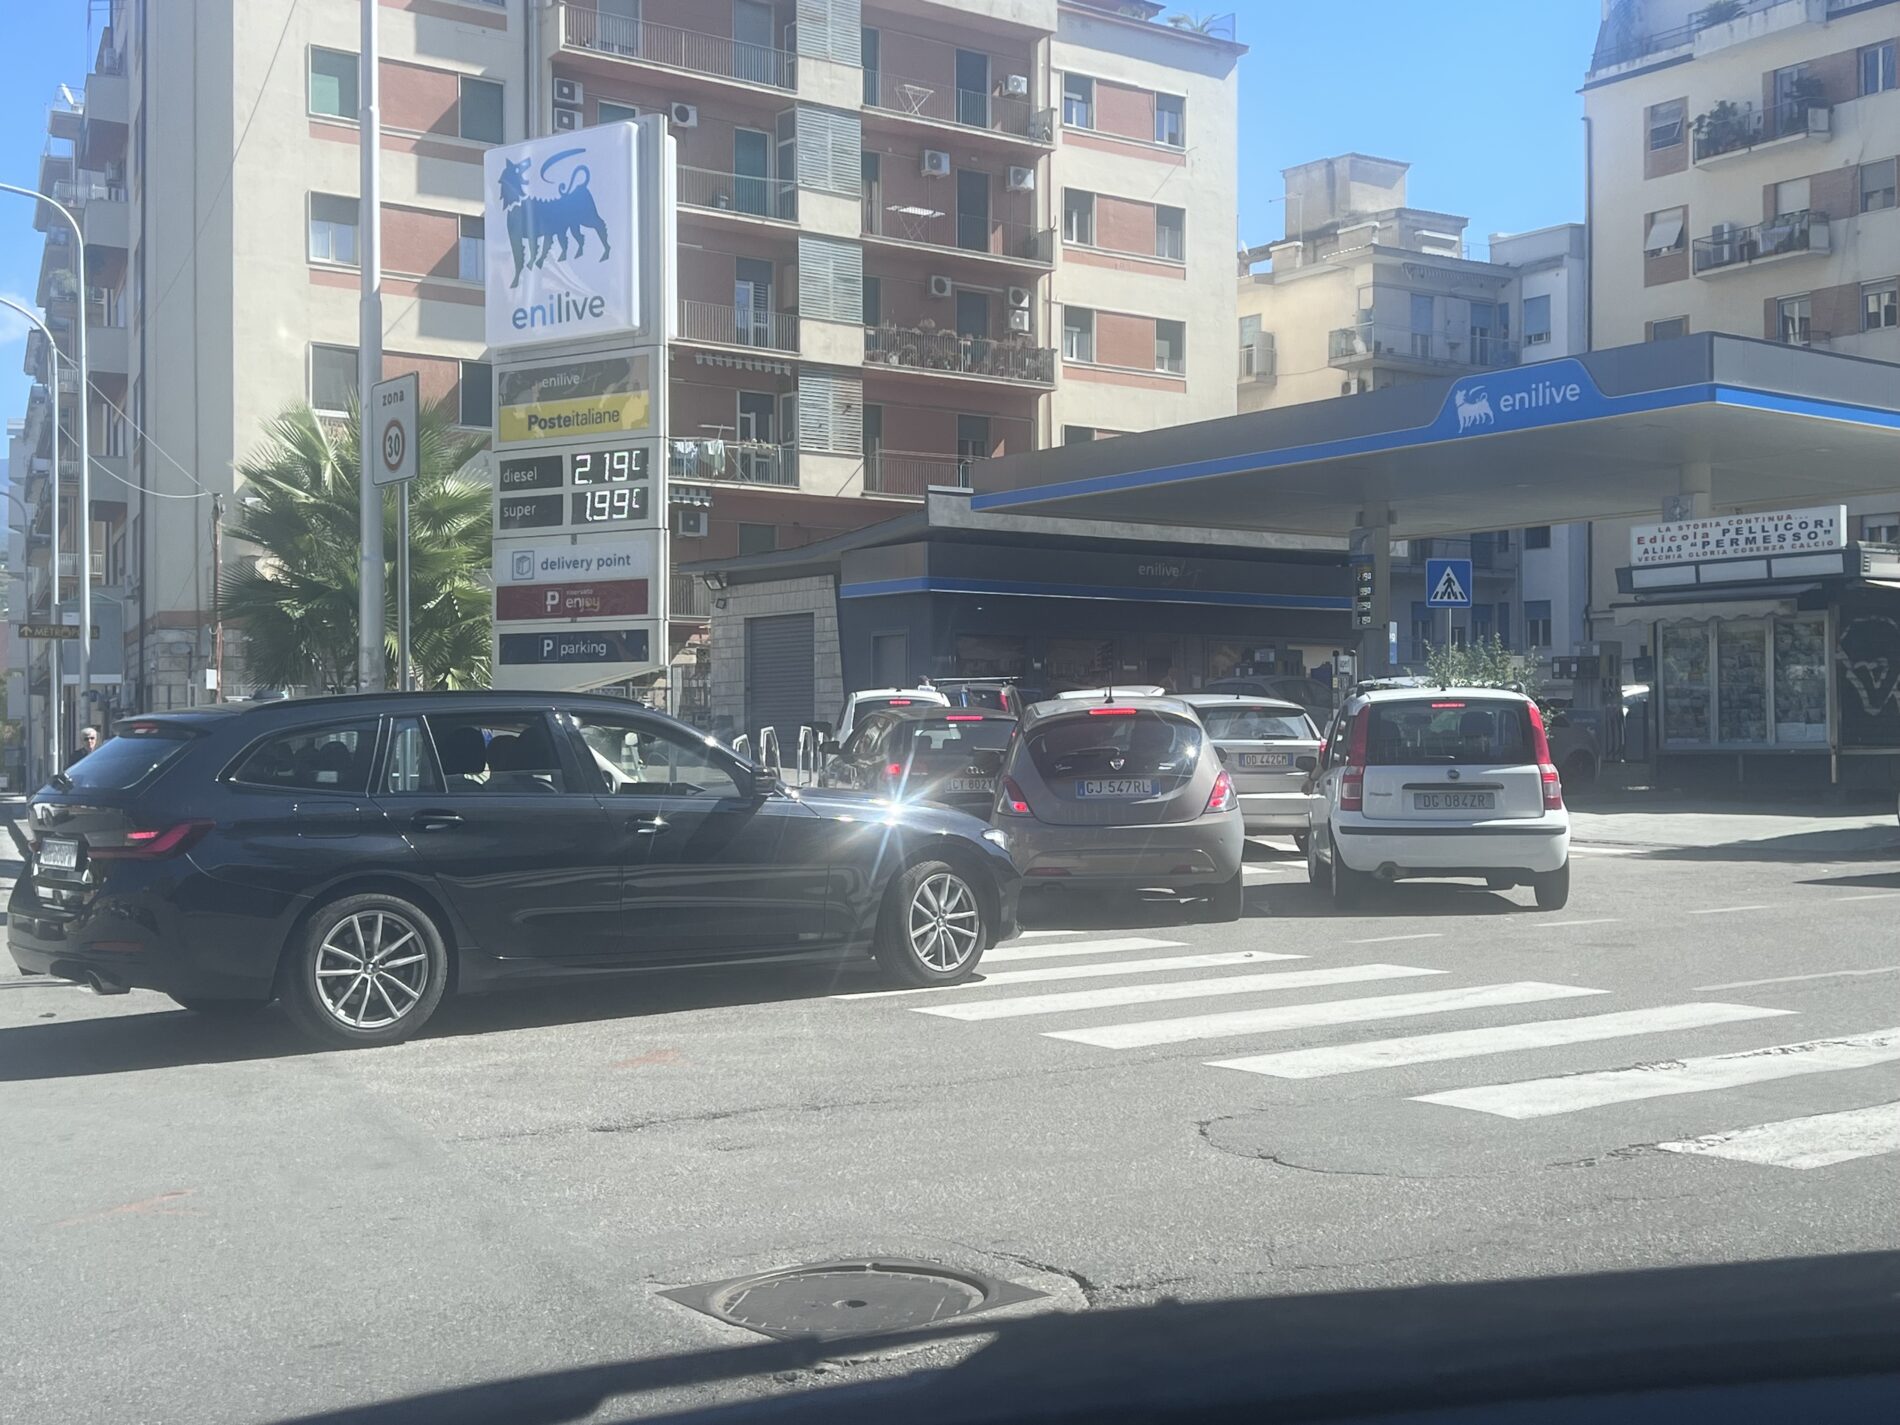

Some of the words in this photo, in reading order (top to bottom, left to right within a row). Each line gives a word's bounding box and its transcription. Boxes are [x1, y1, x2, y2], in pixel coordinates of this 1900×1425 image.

[512, 291, 605, 330] enilive
[542, 373, 580, 389] enilive
[382, 390, 405, 406] zona
[1500, 381, 1581, 412] enilive
[527, 408, 620, 431] Posteitaliane
[387, 433, 401, 458] 30
[503, 466, 537, 483] diesel
[503, 504, 537, 520] super
[1637, 531, 1709, 545] Edicola
[1722, 518, 1834, 537] PELLICORI
[1677, 521, 1721, 531] STORIA
[1637, 553, 1683, 562] VECCHIA
[1791, 540, 1834, 549] CALCIO
[1643, 544, 1683, 555] ALIAS
[540, 557, 593, 572] delivery
[597, 553, 631, 571] point
[1138, 562, 1180, 577] enilive
[546, 591, 560, 612] P
[543, 639, 554, 657] P
[560, 640, 607, 657] parking
[1108, 781, 1150, 793] 547RL
[1444, 794, 1486, 808] 084ZR
